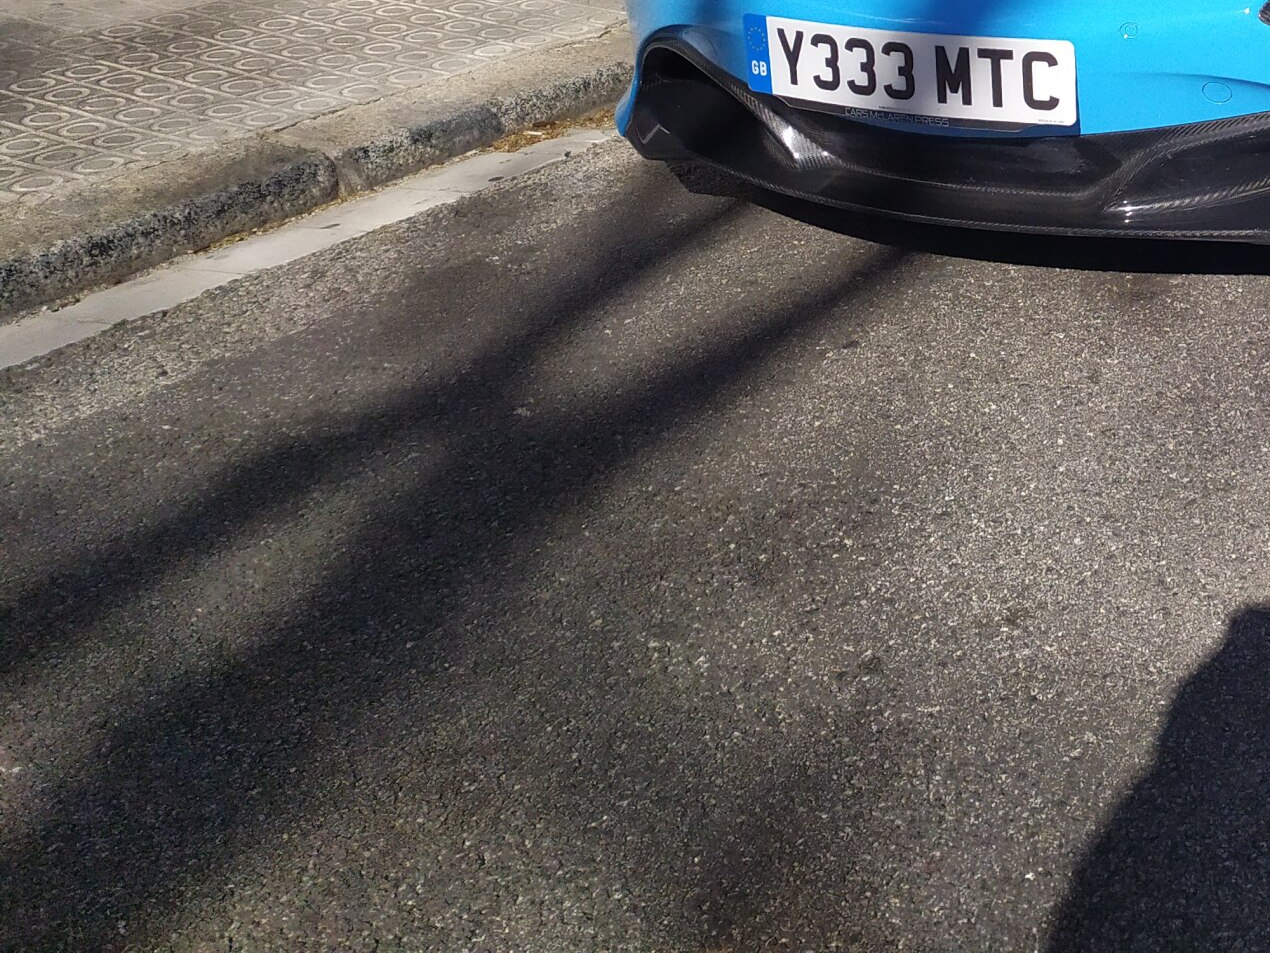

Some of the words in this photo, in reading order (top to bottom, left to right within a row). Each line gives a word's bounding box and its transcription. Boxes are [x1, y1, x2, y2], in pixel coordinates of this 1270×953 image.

[751, 59, 768, 77] GB
[776, 27, 916, 100] Y333
[934, 44, 1060, 111] MTC
